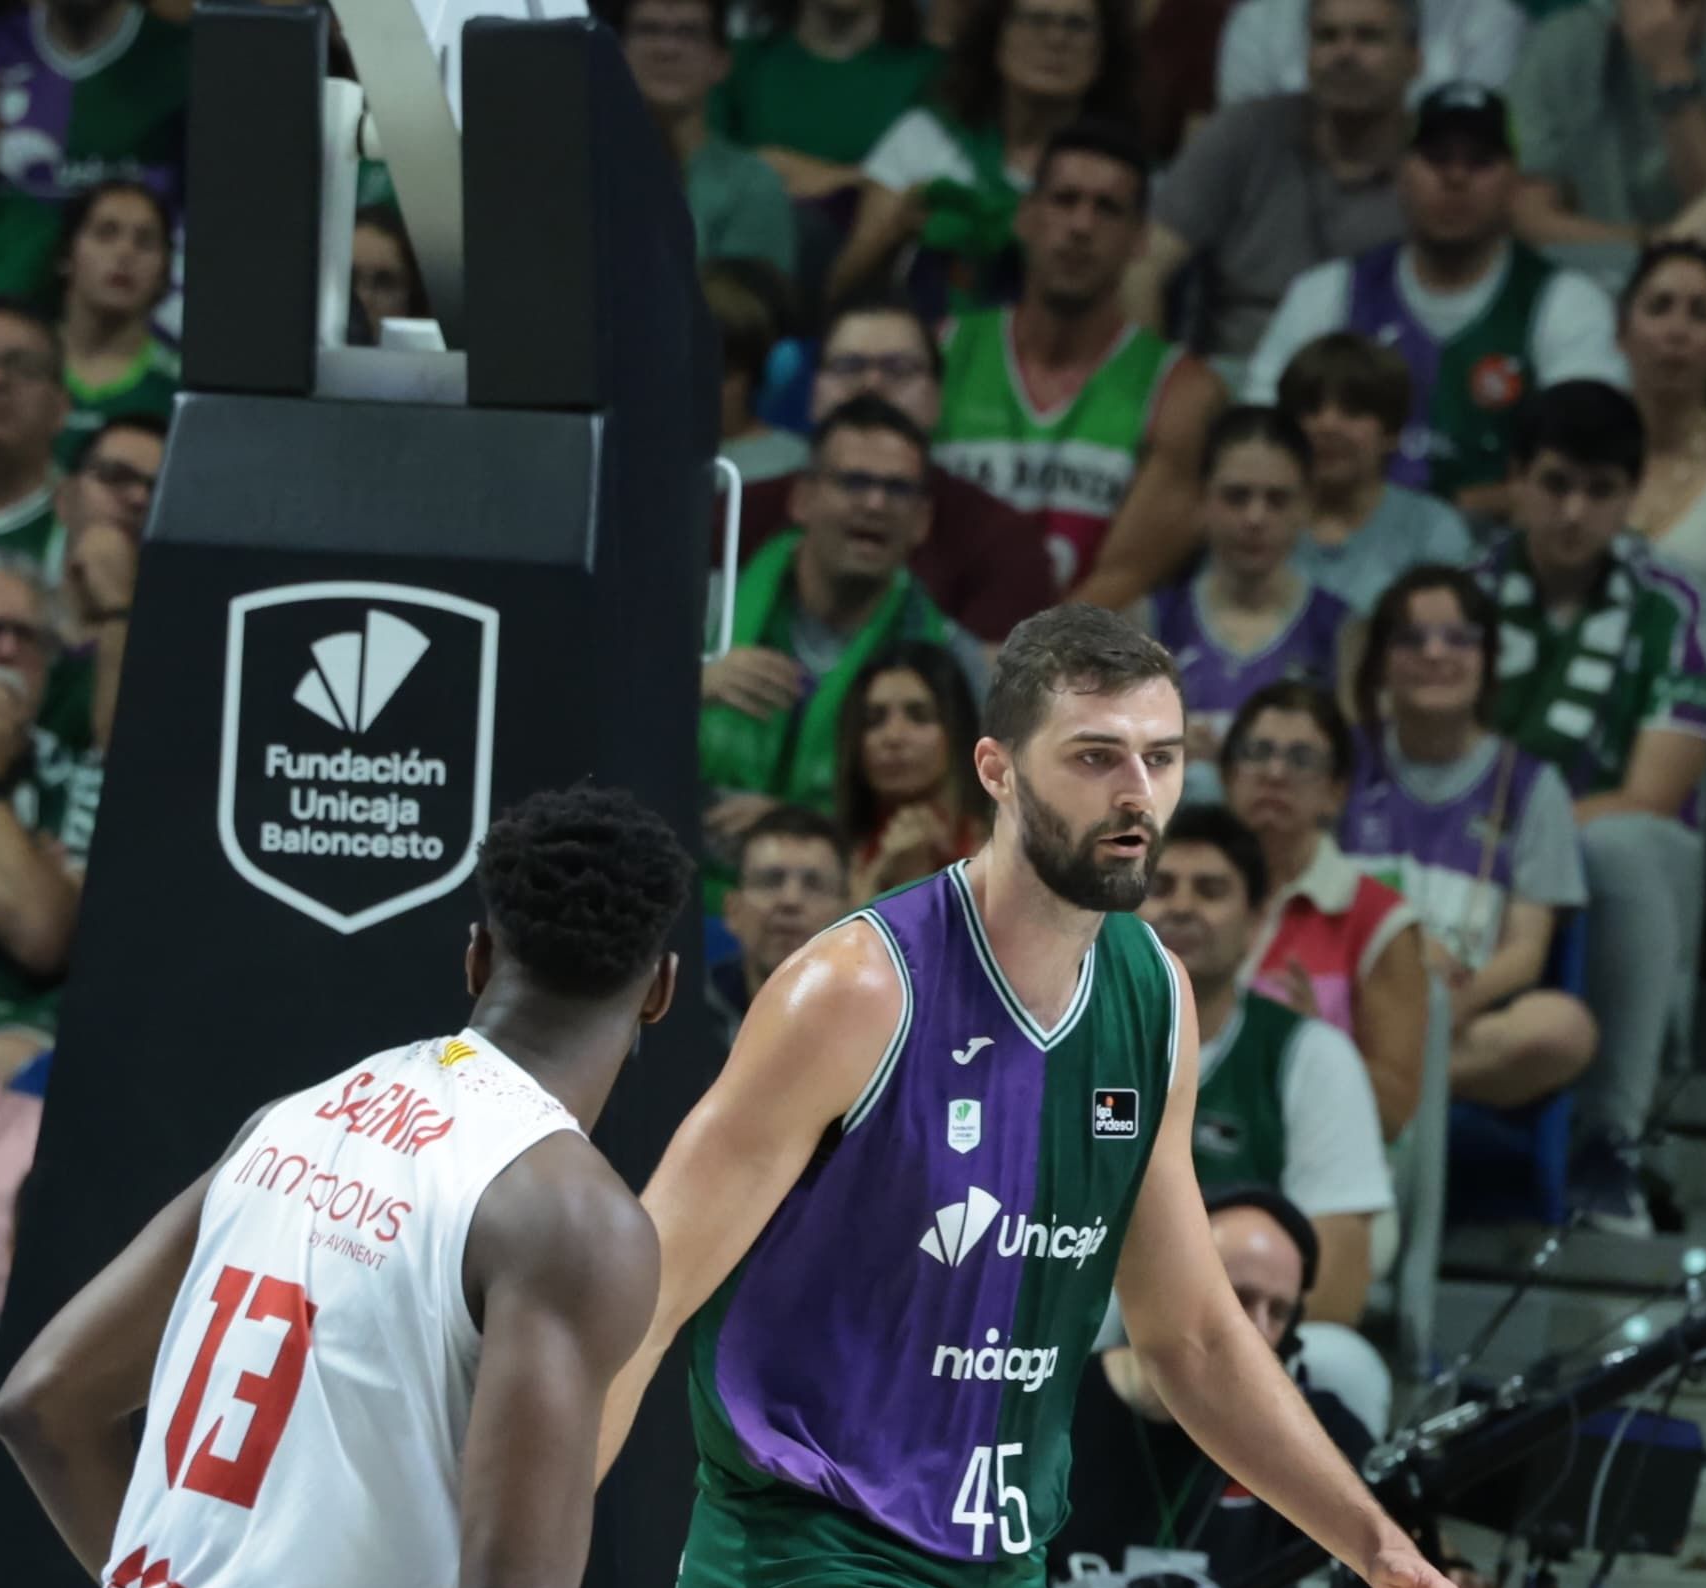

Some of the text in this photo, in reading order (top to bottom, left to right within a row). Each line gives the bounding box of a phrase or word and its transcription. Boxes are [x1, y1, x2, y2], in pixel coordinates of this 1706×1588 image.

[264, 744, 446, 786] Fundación
[290, 788, 420, 833] Unicaja
[260, 823, 444, 861] Baloncesto
[325, 1232, 387, 1271] AVINENT
[164, 1264, 319, 1510] 13
[950, 1442, 1033, 1556] 45
